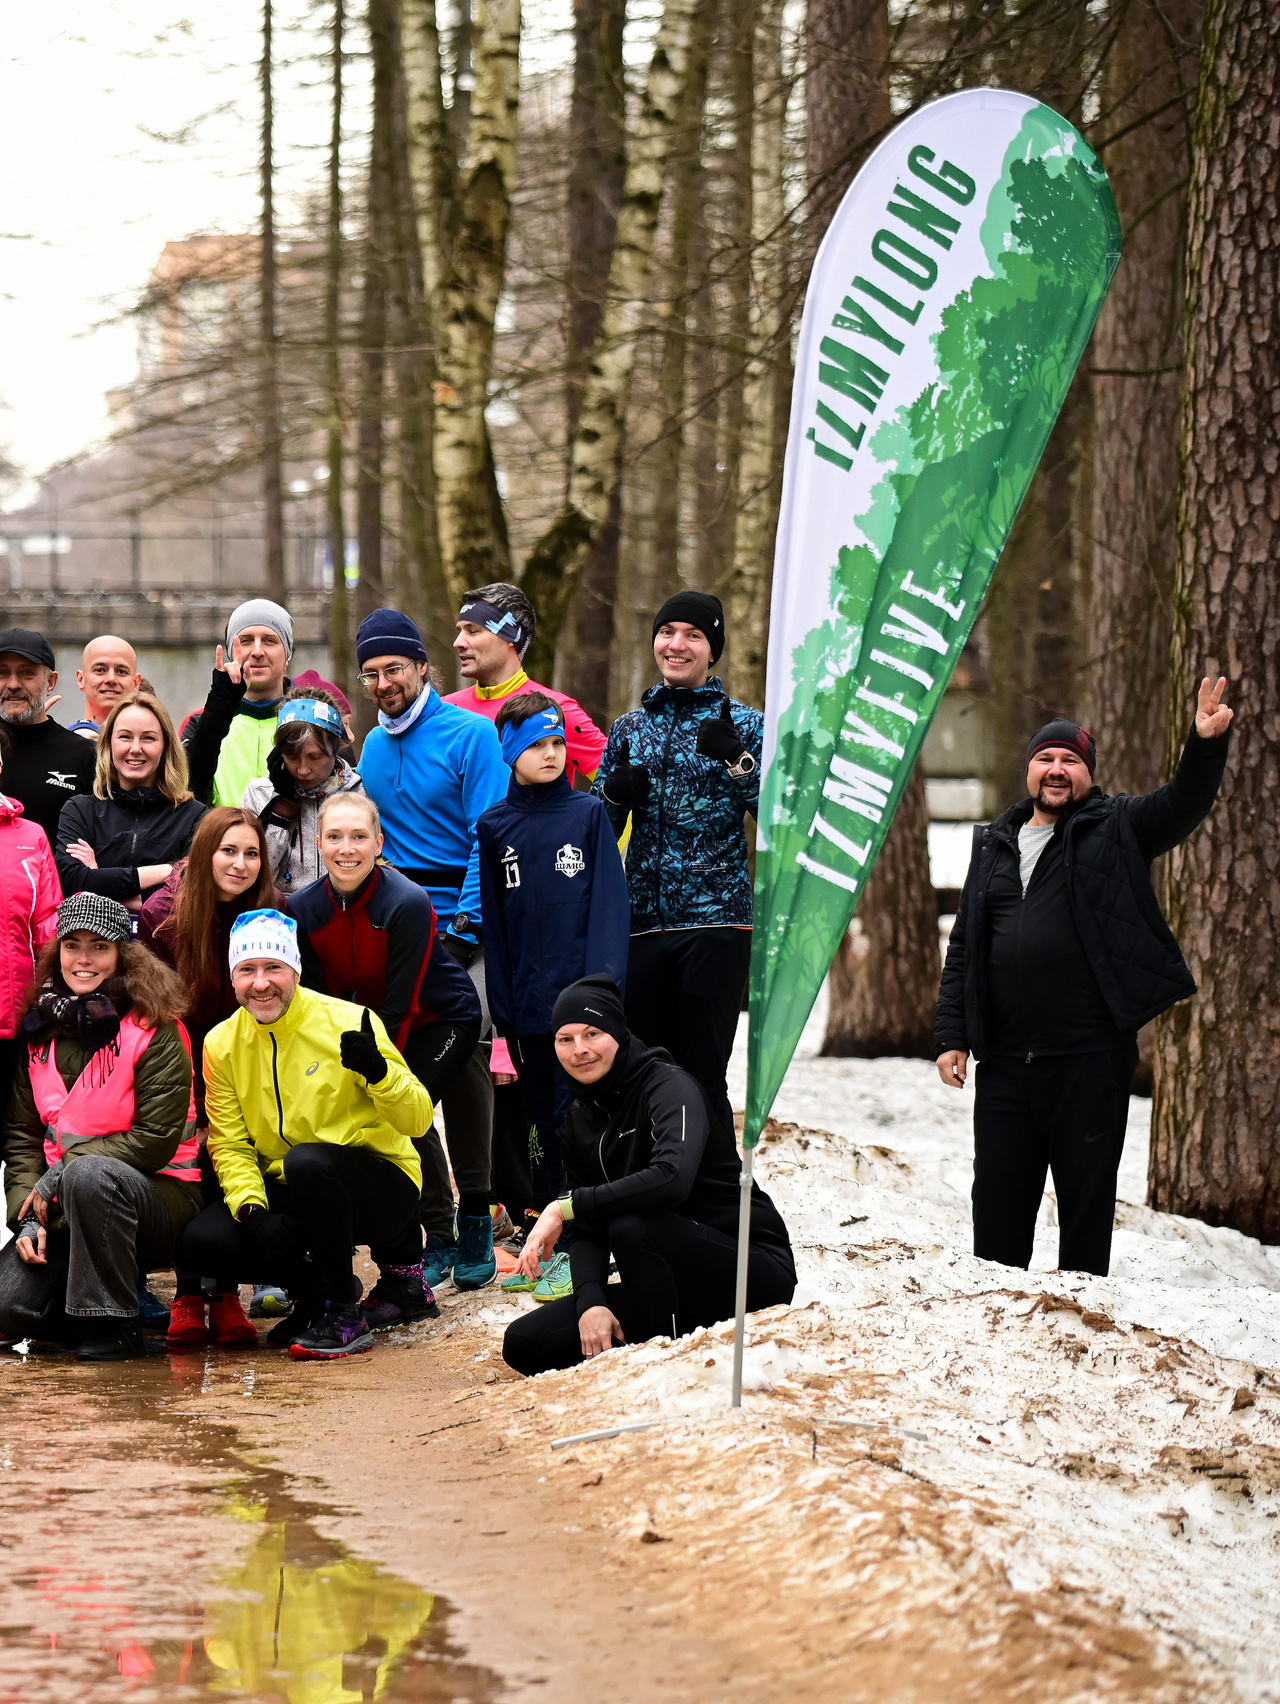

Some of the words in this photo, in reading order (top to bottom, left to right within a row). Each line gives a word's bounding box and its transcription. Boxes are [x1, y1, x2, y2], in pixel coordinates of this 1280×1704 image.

[805, 144, 977, 473] IZMYLONG
[505, 862, 521, 889] 11
[795, 570, 966, 894] IZMYFIVE
